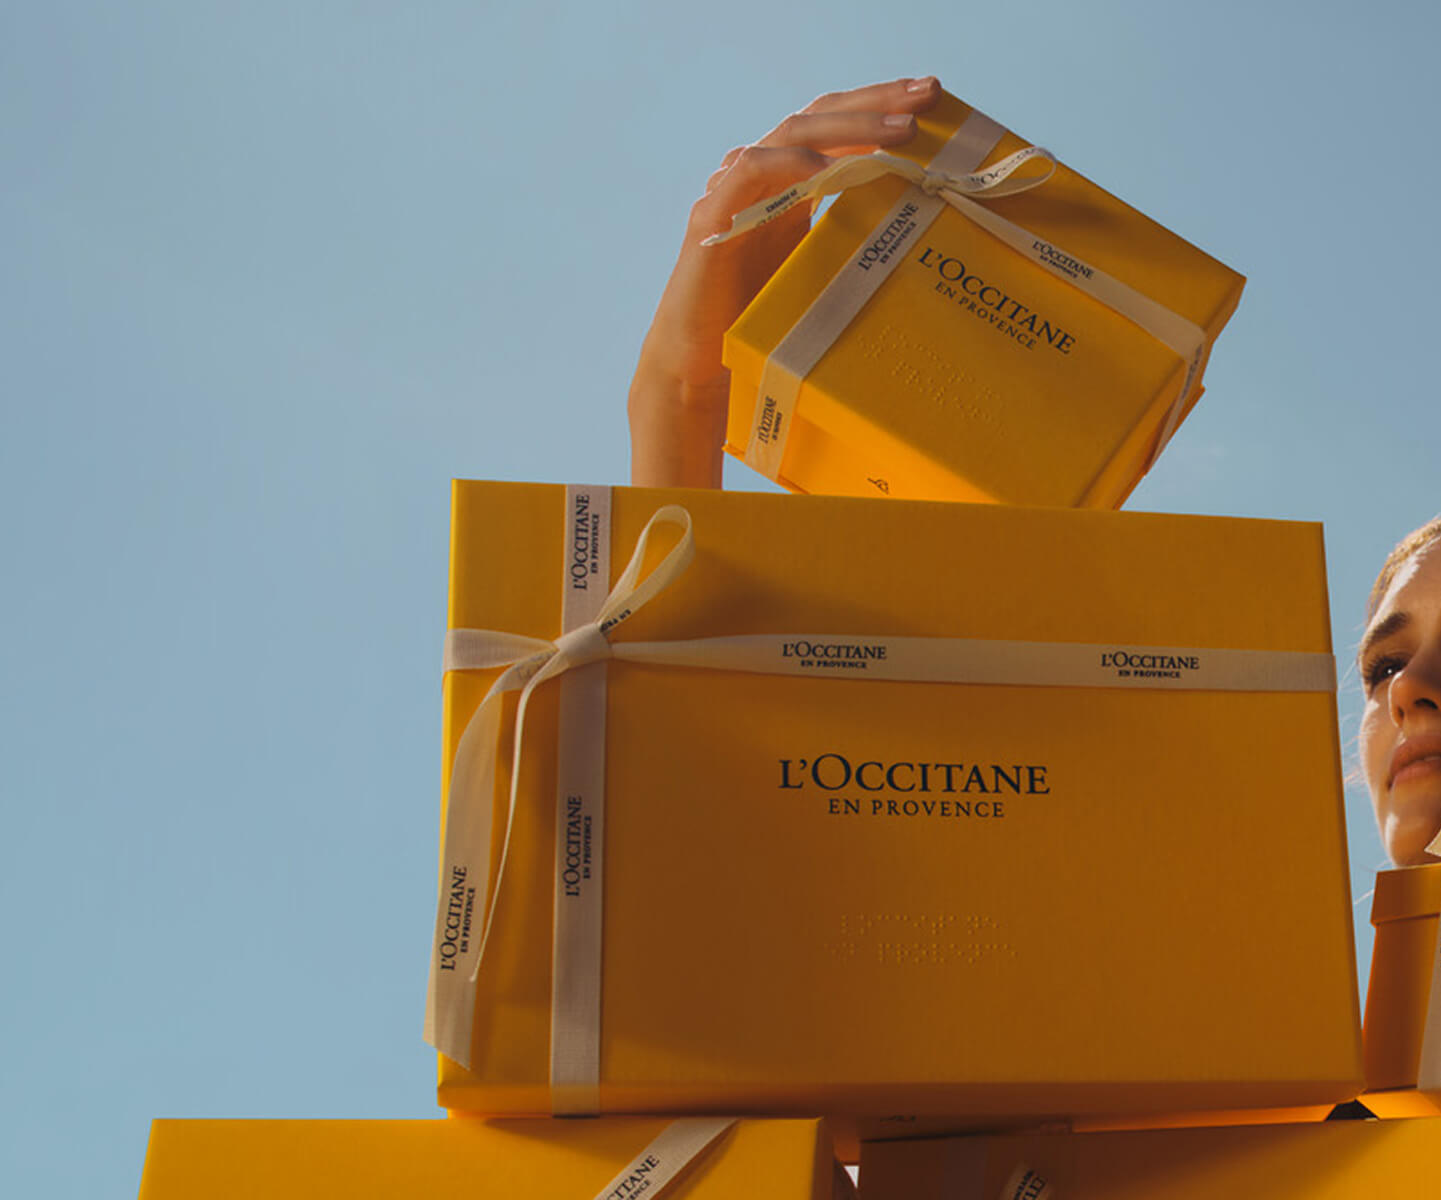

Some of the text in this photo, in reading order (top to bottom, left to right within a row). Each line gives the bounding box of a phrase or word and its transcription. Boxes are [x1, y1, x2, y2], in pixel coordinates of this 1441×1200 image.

[858, 202, 919, 271] L'OCCITANE
[1032, 241, 1094, 279] L'OCCITANE
[918, 247, 1076, 354] L'OCCITANE
[935, 281, 1037, 350] EN PROVENCE
[570, 494, 590, 590] L'OCCITANE
[782, 640, 887, 660] L'OCCITANE
[817, 660, 867, 669] PROVENCE
[1100, 650, 1200, 670] L'OCCITANE
[1118, 669, 1181, 679] EN PROVENCE
[778, 753, 1050, 795] L'OCCITANE
[828, 798, 1005, 818] EN PROVENCE
[562, 795, 582, 896] L'OCCITANE
[440, 865, 467, 971] L'OCCITANE
[460, 887, 476, 953] EN PROVENCE
